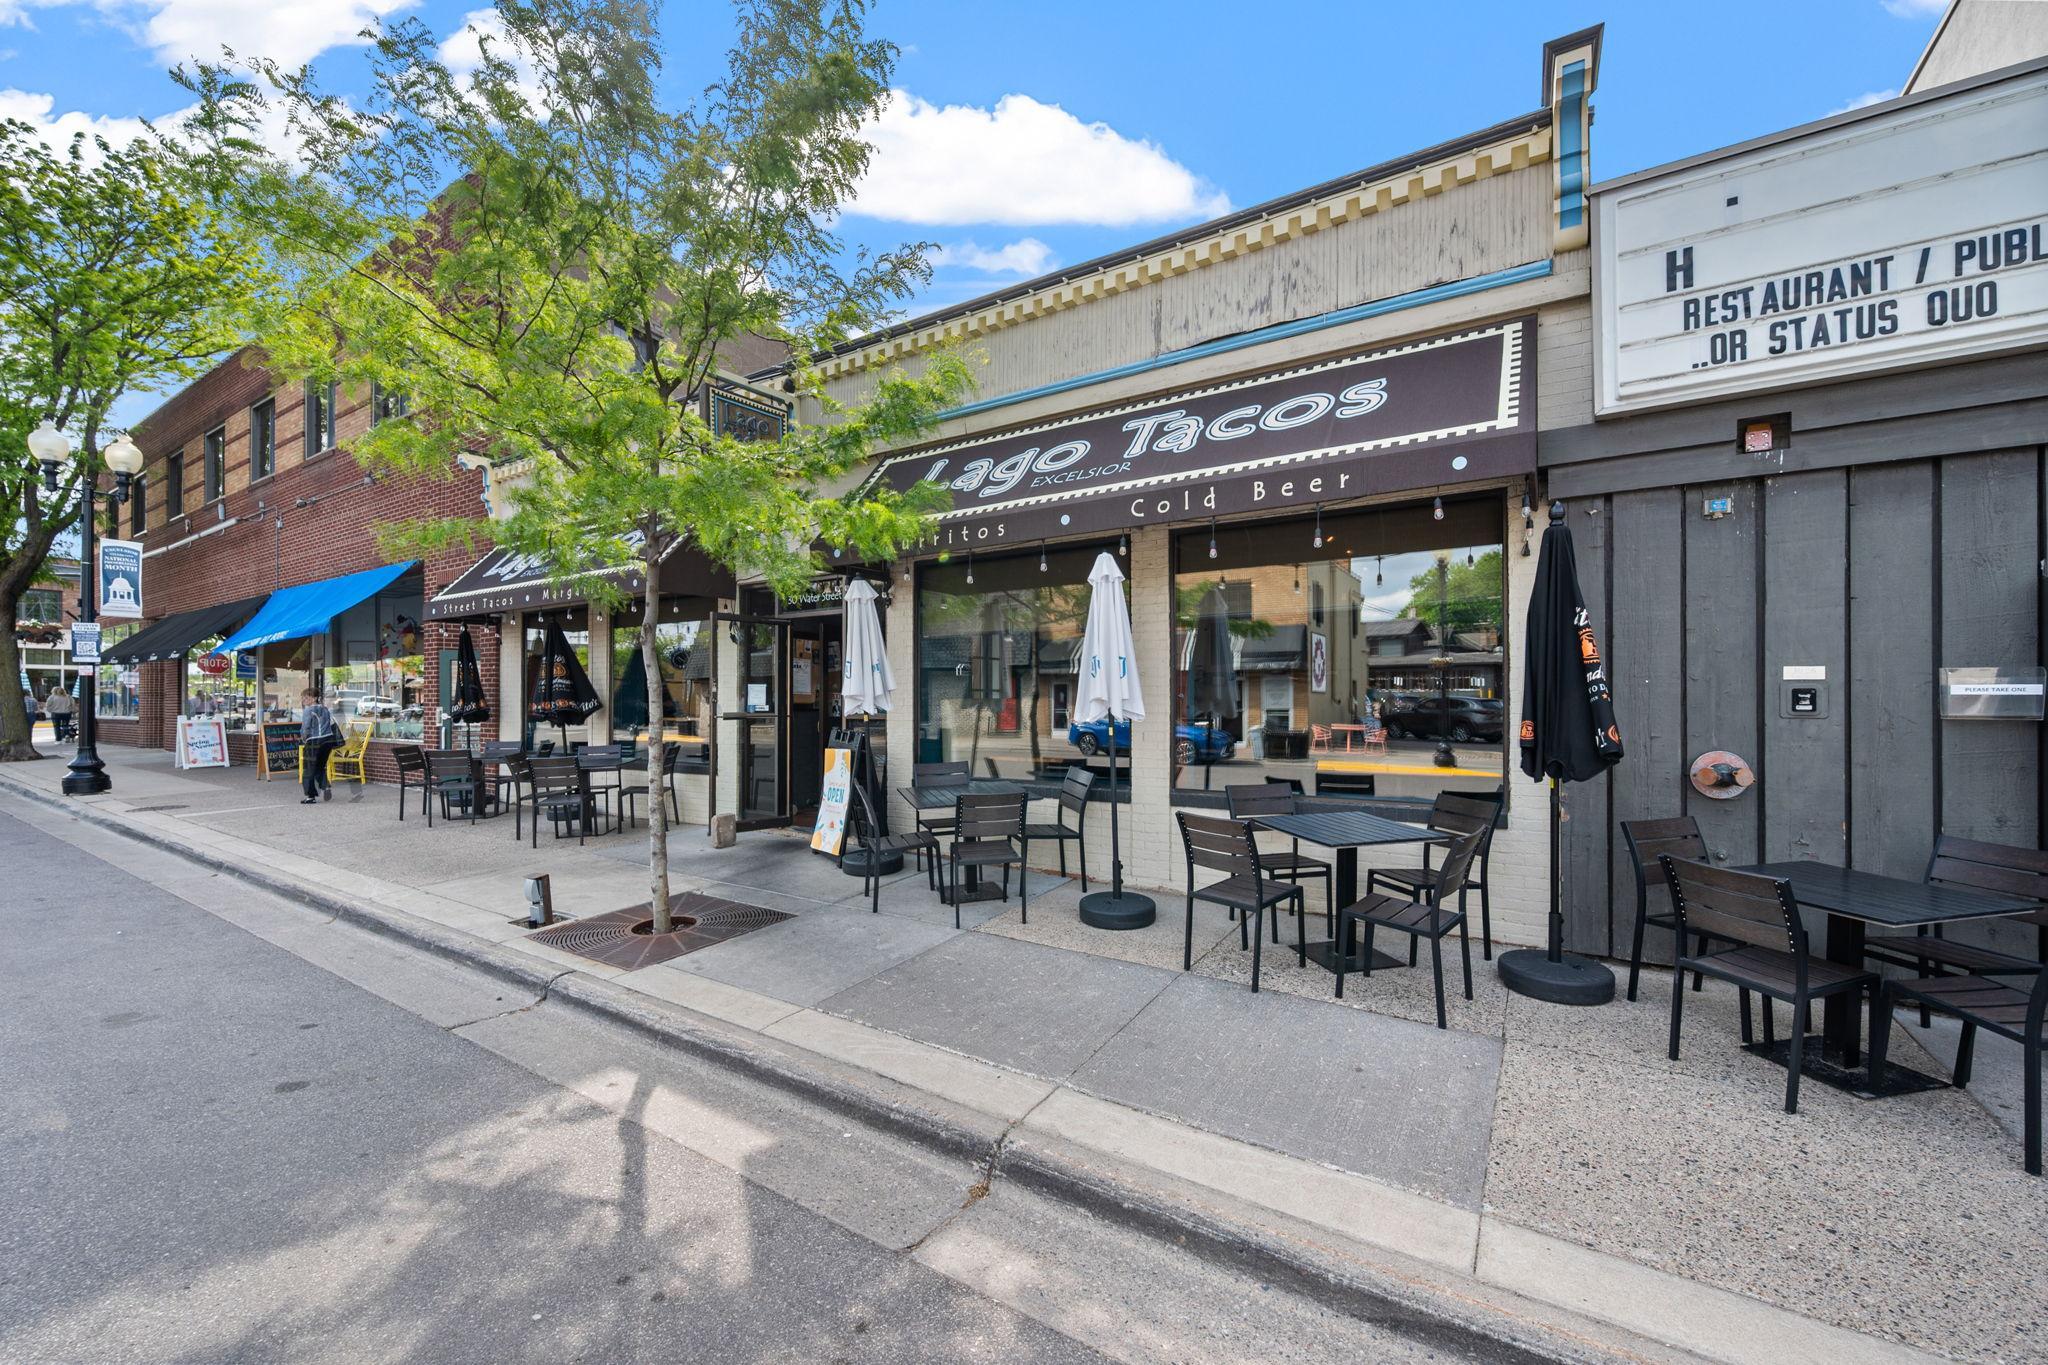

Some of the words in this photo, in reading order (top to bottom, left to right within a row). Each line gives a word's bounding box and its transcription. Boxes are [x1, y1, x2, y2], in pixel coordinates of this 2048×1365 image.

[1666, 246, 1693, 293] H
[1684, 256, 1894, 331] RESTAURANT
[1955, 224, 2048, 277] PUBL
[1769, 300, 1898, 355] STATUS
[1927, 281, 1997, 326] QUO
[924, 440, 1091, 498] Lago
[1122, 377, 1388, 459] Tacos
[1030, 461, 1131, 488] EXCELSIOR
[1131, 486, 1215, 517] Cold
[1253, 473, 1349, 501] Beer
[902, 524, 1005, 550] urritos
[104, 555, 138, 563] NATIONAL
[104, 564, 138, 572] MONTH
[443, 601, 476, 614] Street
[482, 596, 514, 609] Tacos
[800, 594, 820, 603] Water
[821, 591, 842, 601] Street
[827, 786, 845, 804] OPEN
